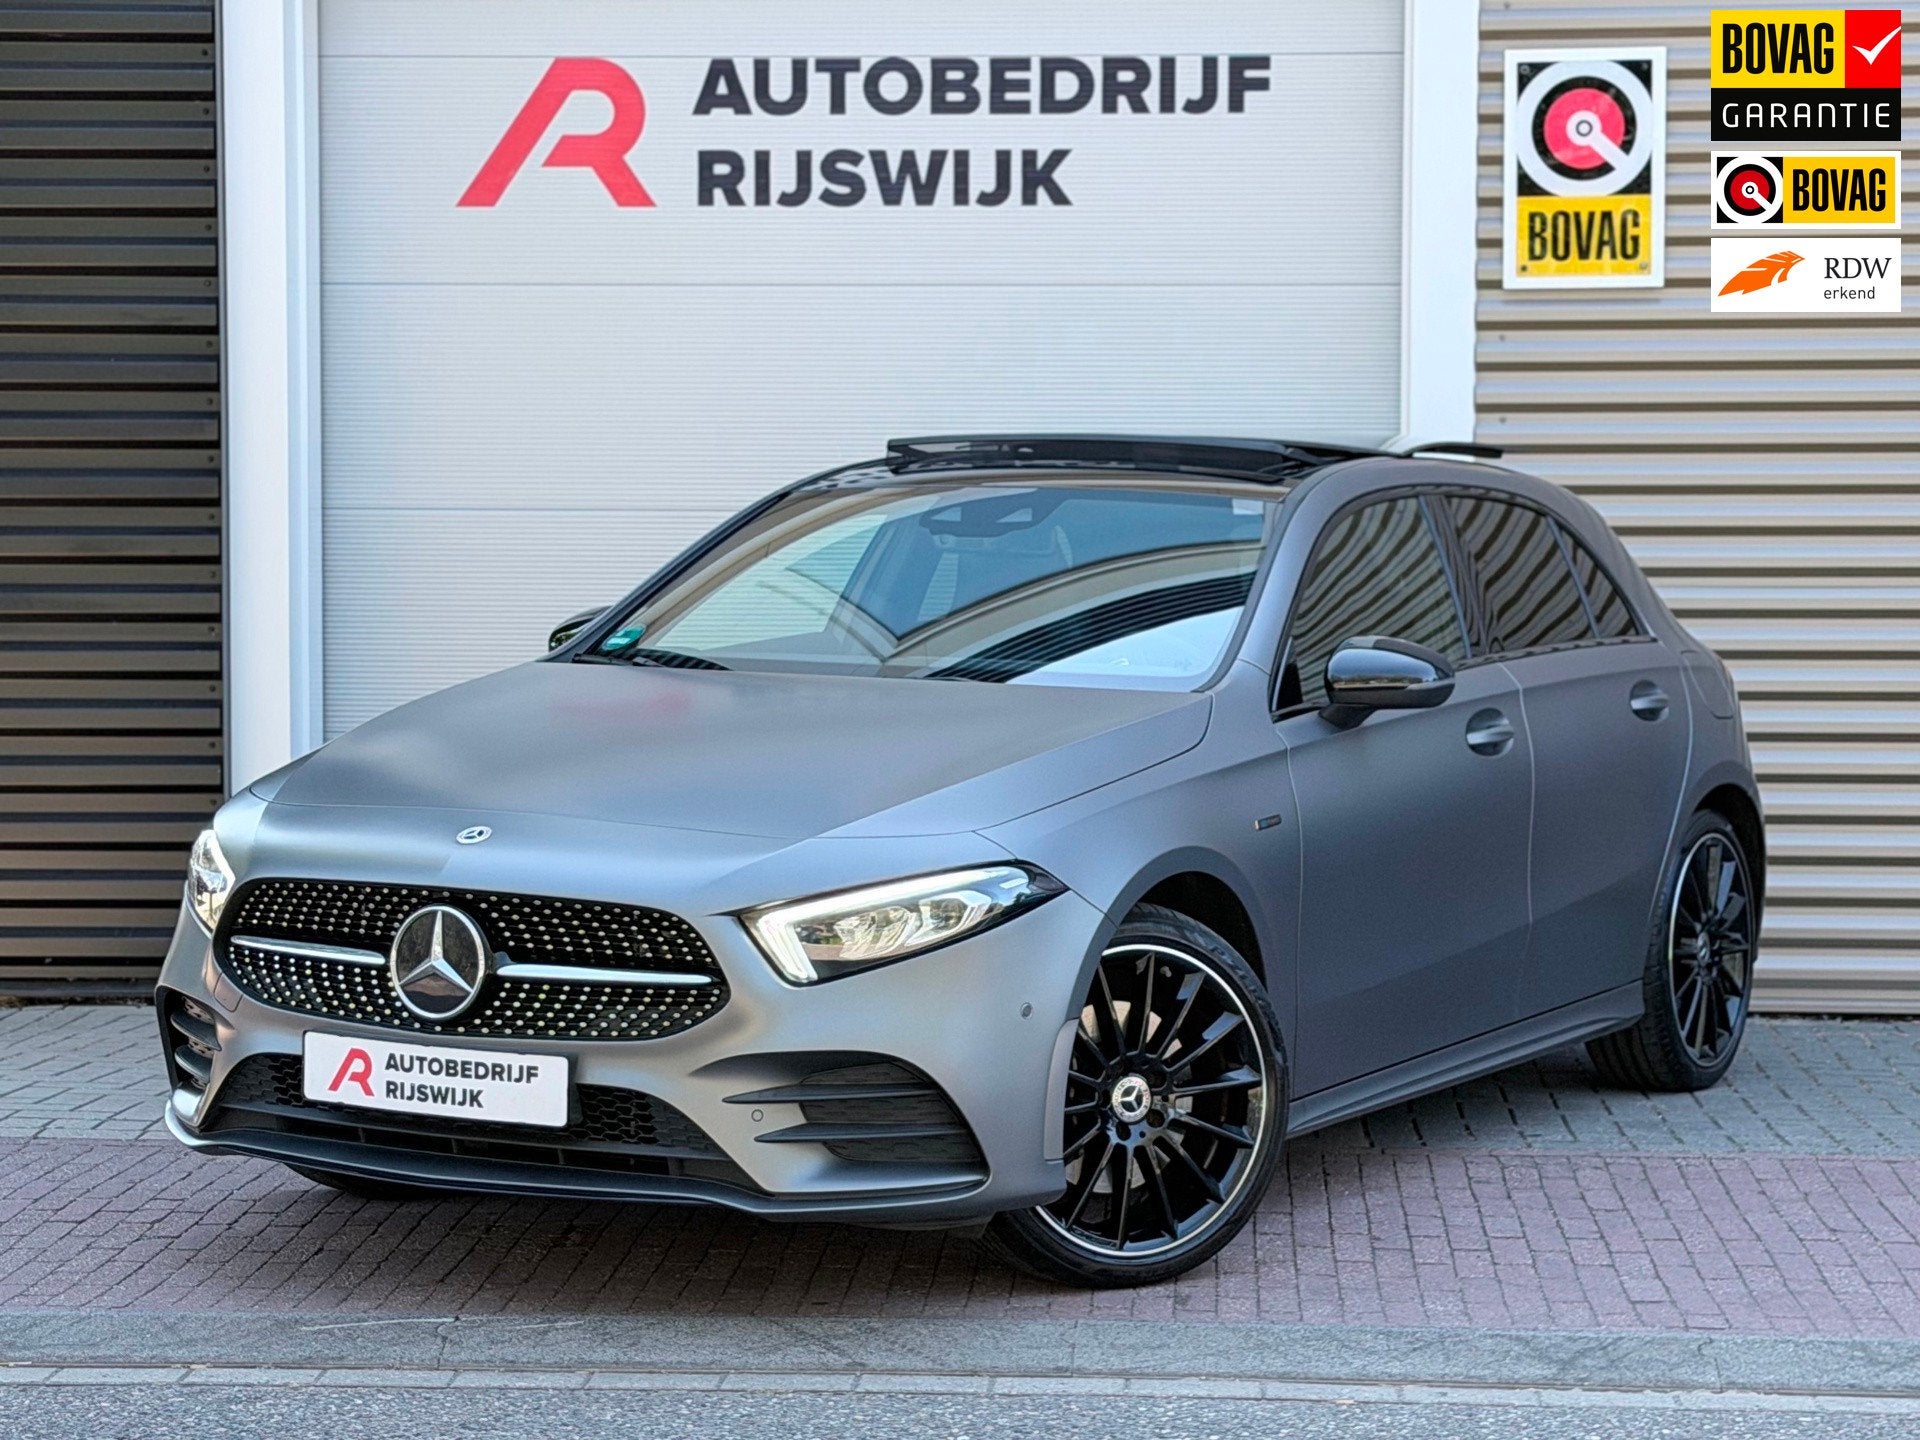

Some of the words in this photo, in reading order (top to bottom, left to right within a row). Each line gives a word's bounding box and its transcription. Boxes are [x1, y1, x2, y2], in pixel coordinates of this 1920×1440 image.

[692, 55, 1271, 116] AUTOBEDRIJF
[697, 149, 1073, 207] RIJSWIJK
[1528, 208, 1641, 262] BOVAG
[384, 1053, 539, 1084] AUTOBEDRIJF
[385, 1080, 484, 1109] RIJSWIJK
